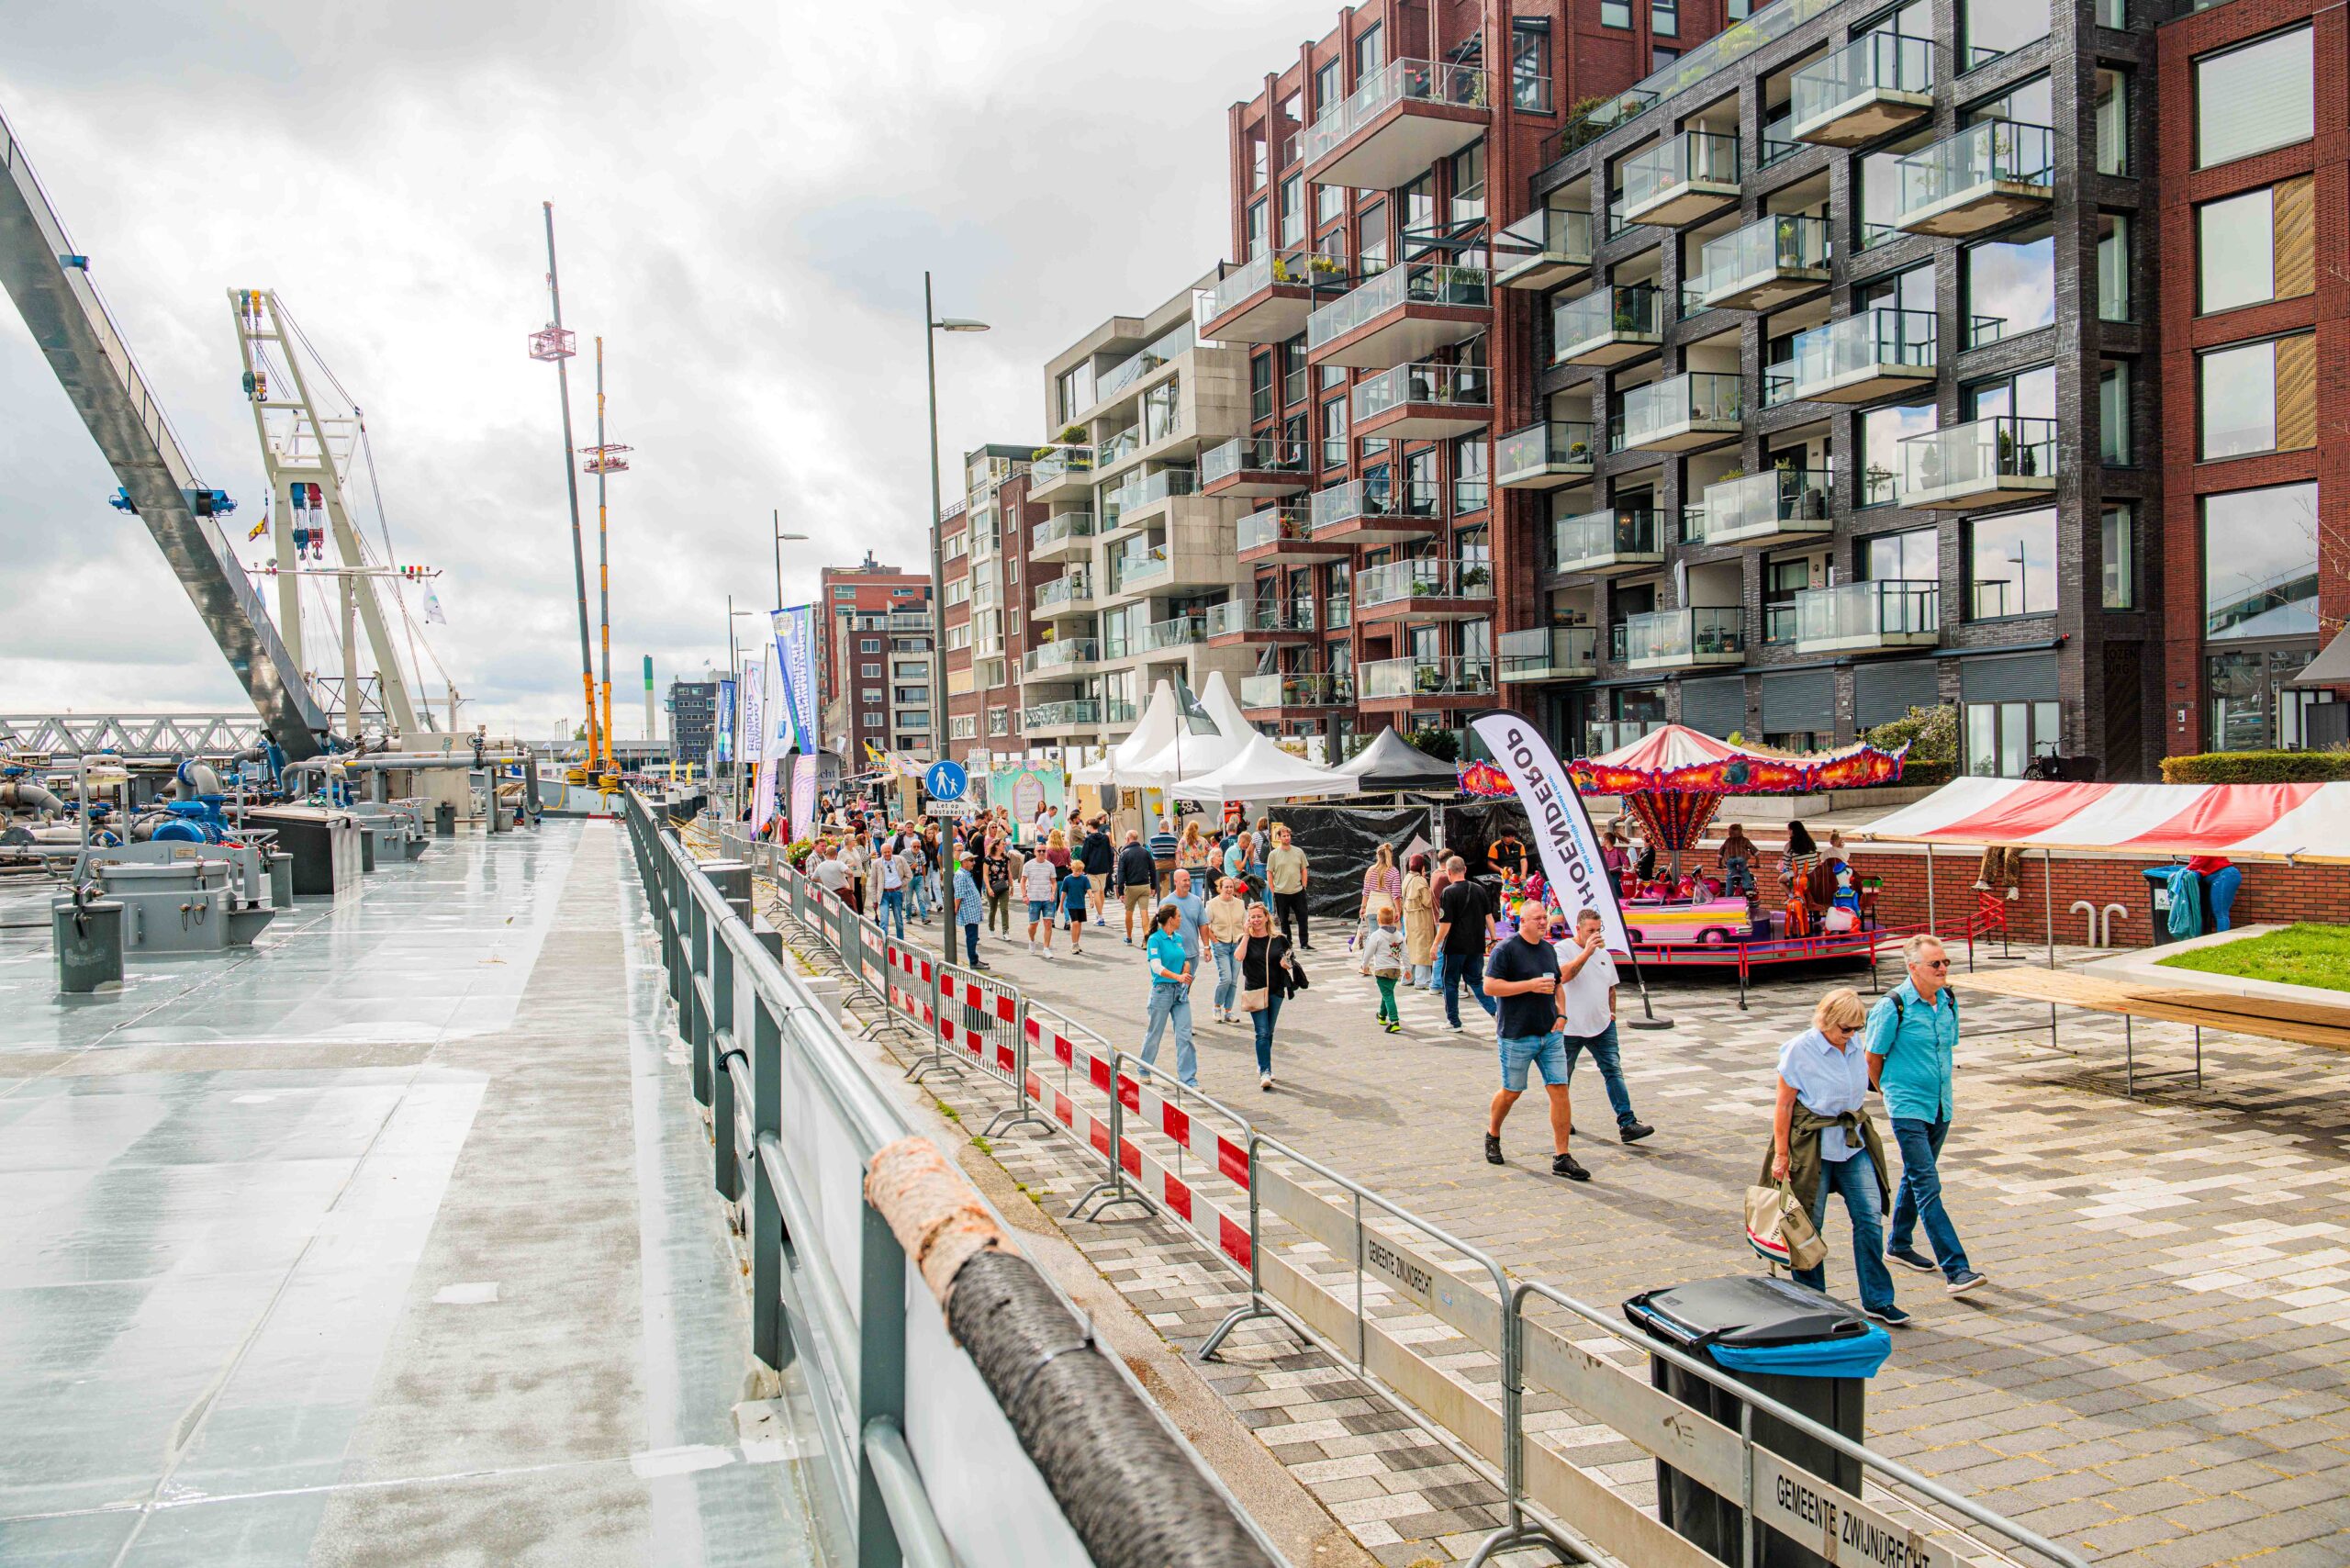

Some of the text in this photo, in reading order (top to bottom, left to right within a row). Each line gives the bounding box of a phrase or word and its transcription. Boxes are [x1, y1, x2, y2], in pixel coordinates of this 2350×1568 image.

[746, 694, 755, 751] REINPLUS
[1369, 1239, 1432, 1299] GEMEENTE ZWIJNDRECHT
[1776, 1474, 1837, 1537] GEMEENTE
